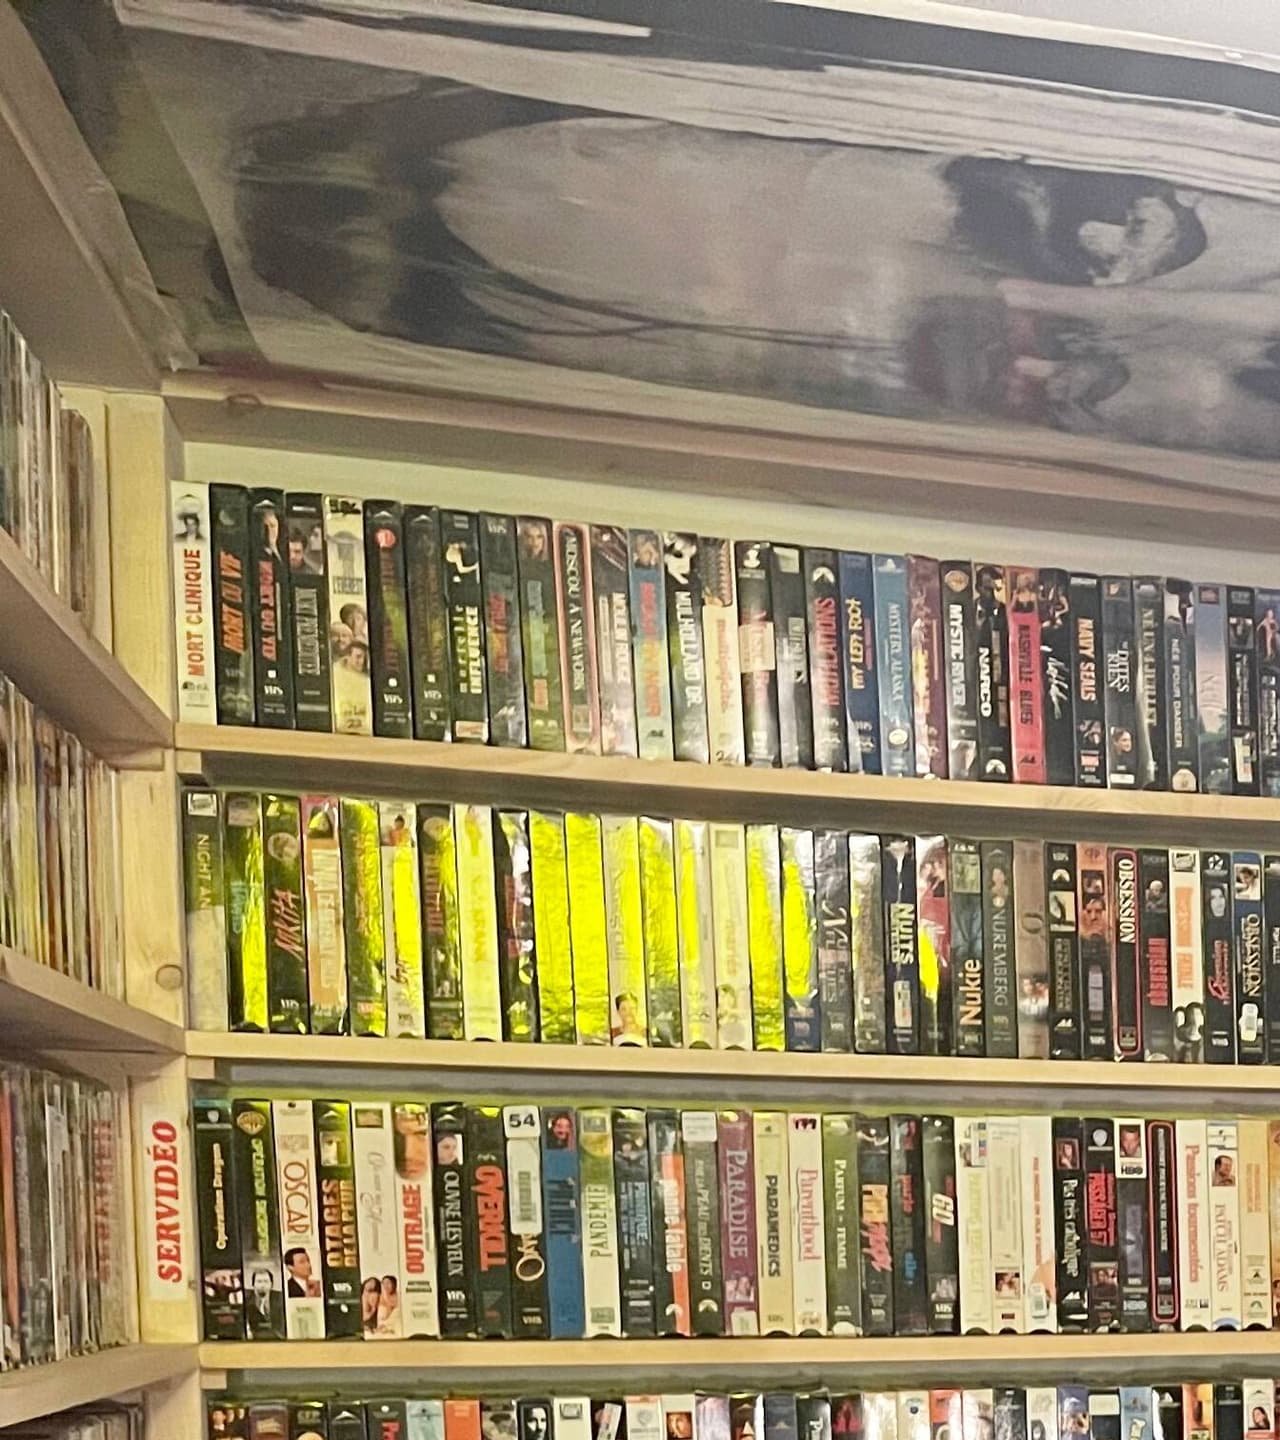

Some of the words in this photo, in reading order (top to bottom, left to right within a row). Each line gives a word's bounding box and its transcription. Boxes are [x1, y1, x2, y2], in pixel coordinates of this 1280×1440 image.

[187, 549, 203, 626] CLINIQUE
[186, 632, 203, 677] MORT
[948, 604, 963, 659] MYSTIC
[1077, 618, 1094, 657] NAVY
[950, 662, 965, 707] RIVER
[977, 647, 990, 717] NARCO
[1078, 662, 1096, 701] SEALS
[198, 834, 210, 881] NIGHT
[901, 902, 914, 964] NUITS
[1118, 860, 1135, 943] OBSESSION
[960, 959, 982, 1025] Nukie
[509, 1113, 536, 1128] 54
[148, 1120, 184, 1283] SERVIDÉO
[284, 1161, 310, 1233] OSCAR
[323, 1179, 339, 1268] OTAGES
[403, 1183, 428, 1275] OUTRAGE
[725, 1149, 748, 1260] PARADISE
